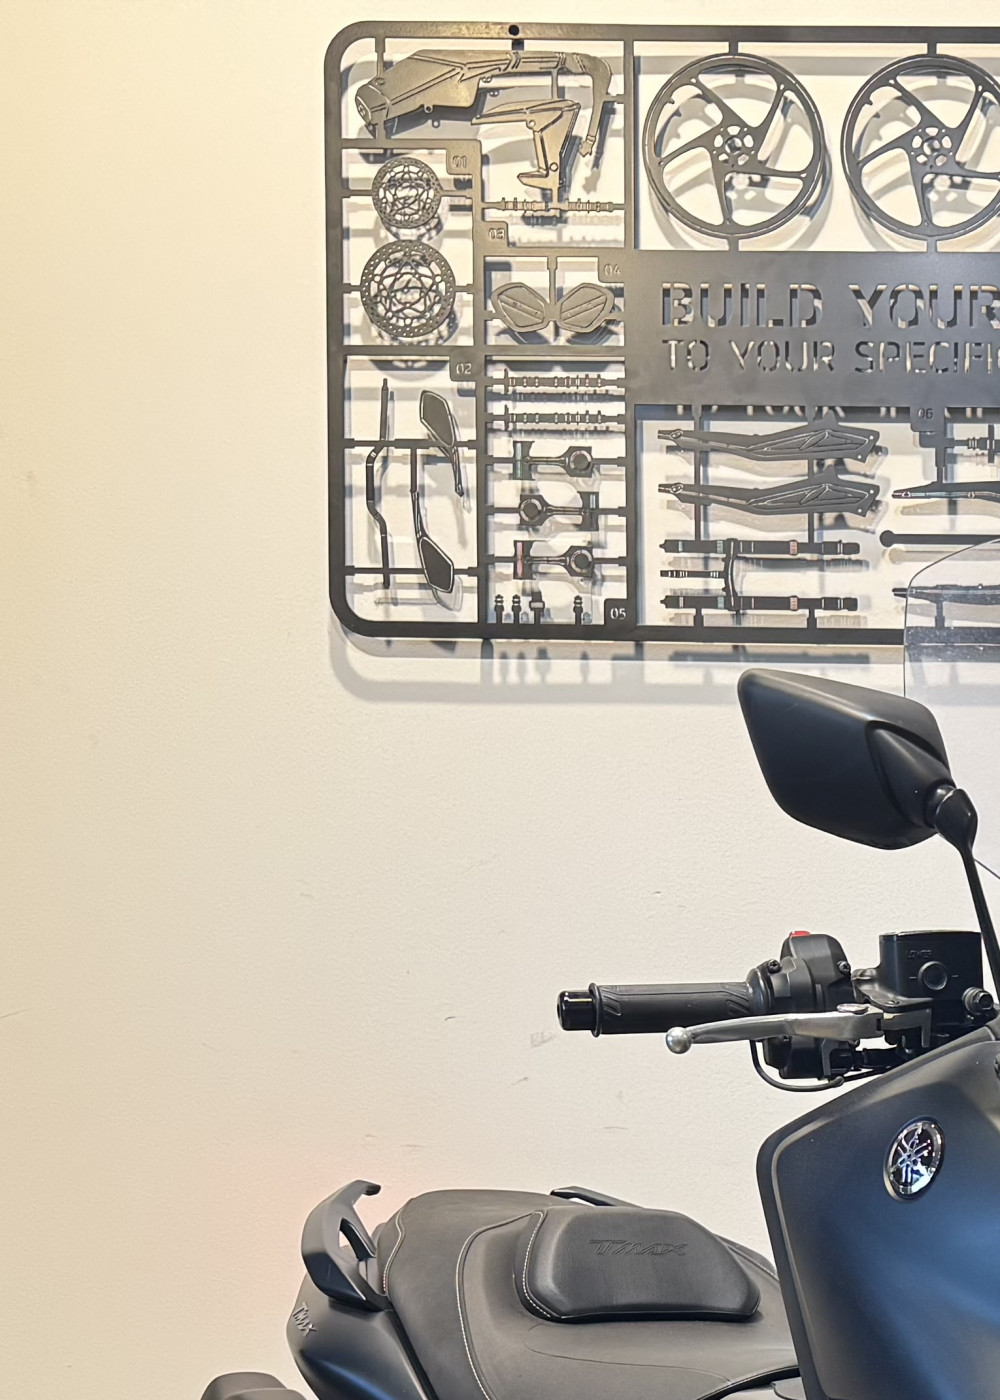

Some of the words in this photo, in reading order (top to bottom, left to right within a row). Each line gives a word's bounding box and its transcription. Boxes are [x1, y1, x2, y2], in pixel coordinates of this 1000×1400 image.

[452, 155, 467, 168] 01
[603, 263, 620, 276] 04
[661, 283, 823, 328] BUILD
[661, 339, 709, 372] TO
[730, 340, 835, 373] YOUR
[456, 363, 472, 375] 02
[917, 408, 933, 419] 06
[610, 608, 626, 620] 05
[589, 1239, 688, 1256] TMAX
